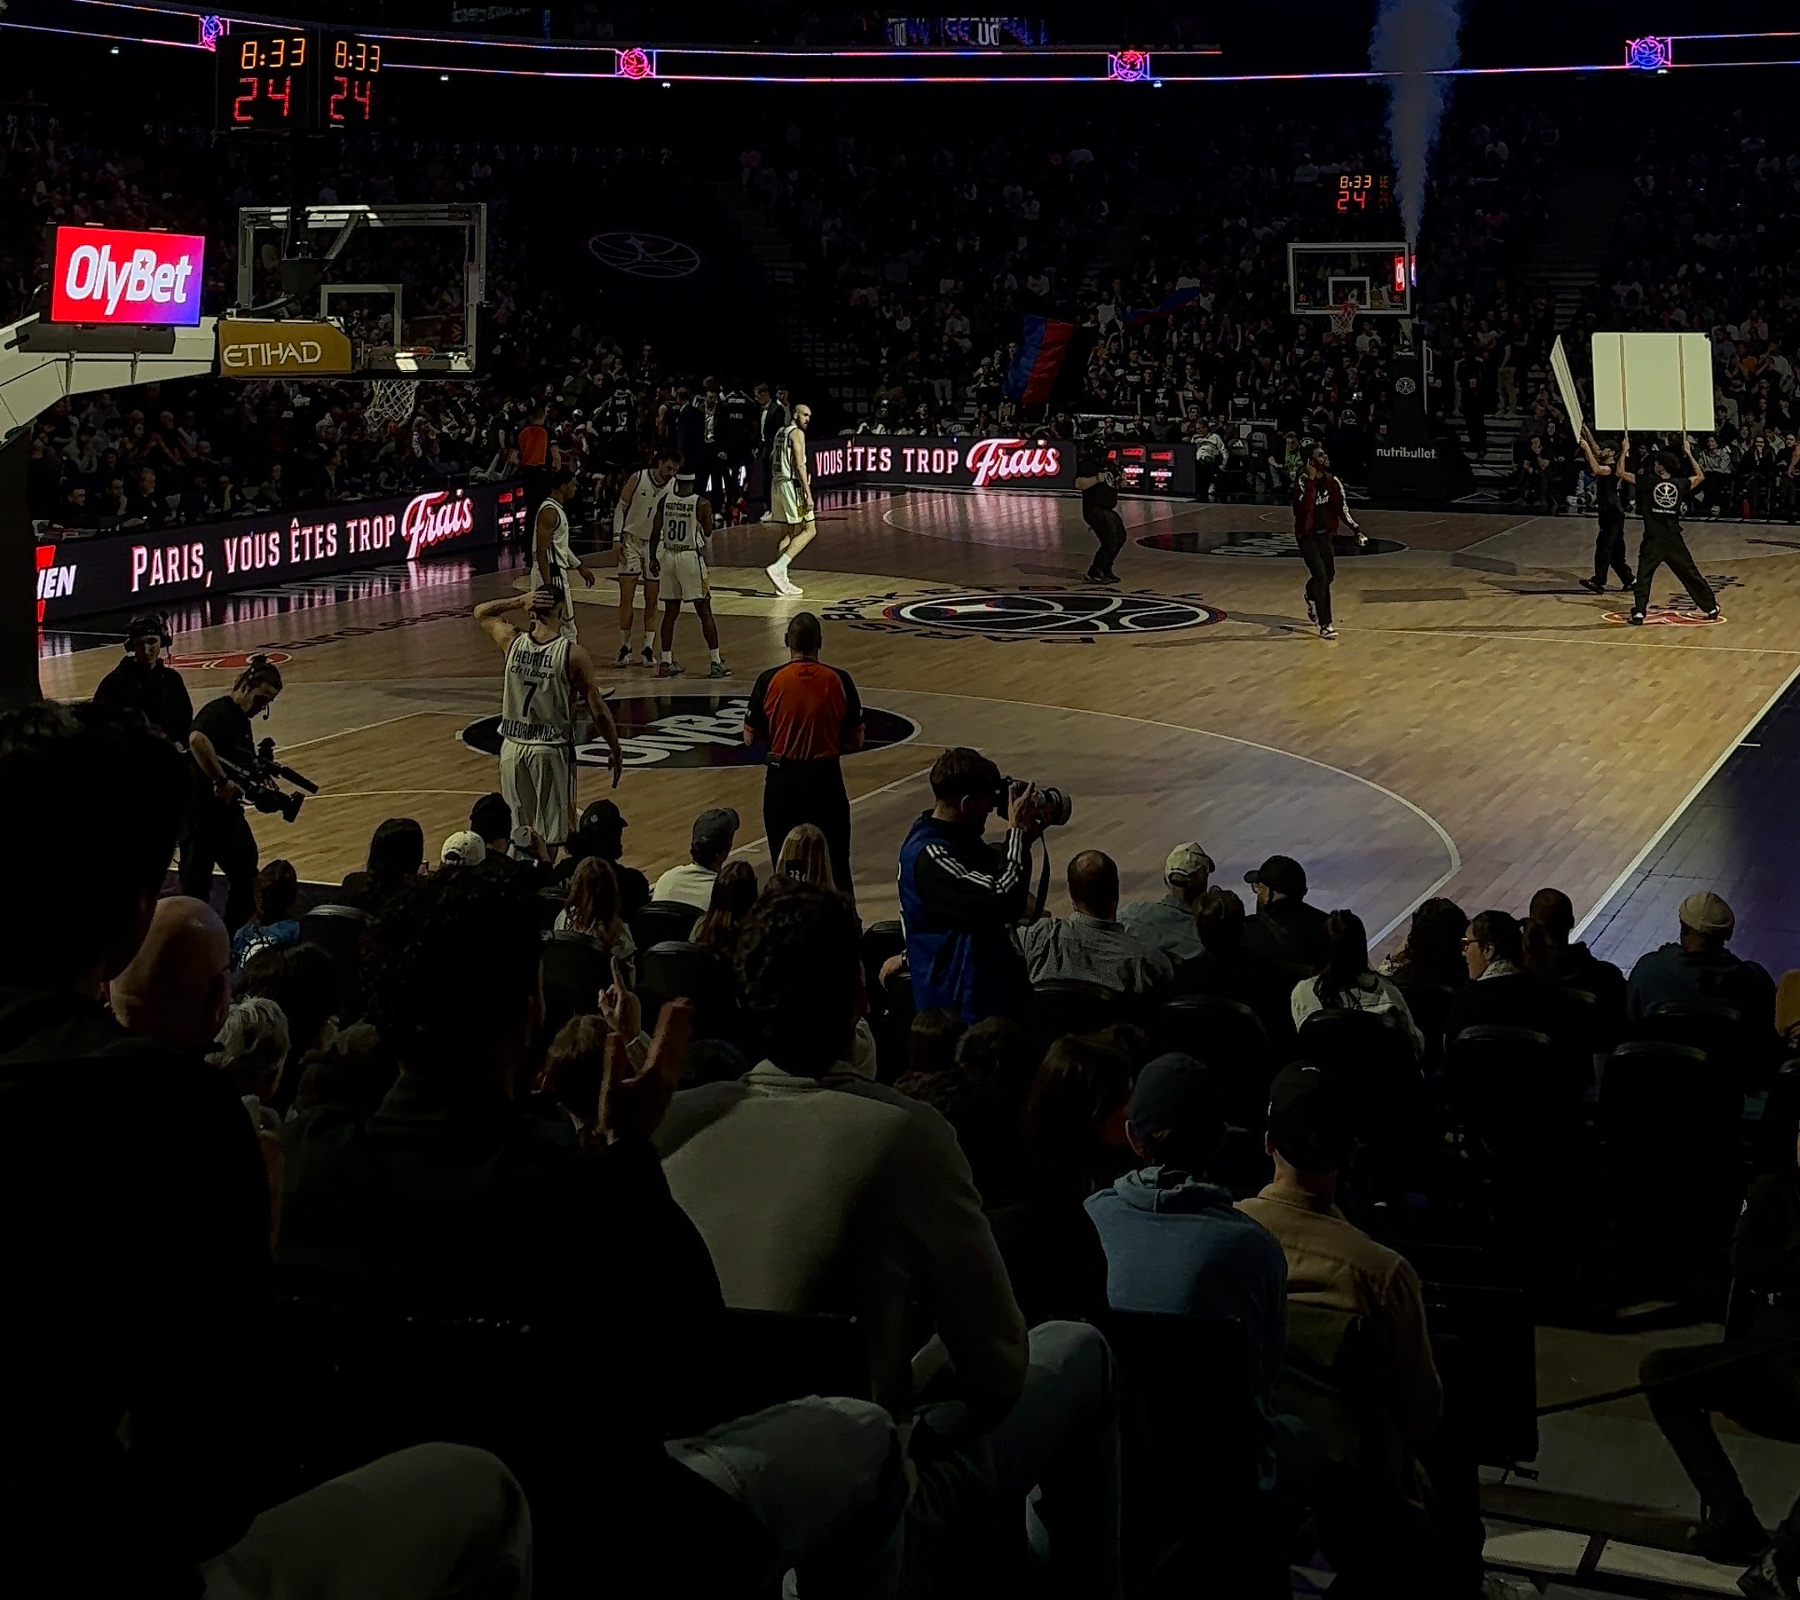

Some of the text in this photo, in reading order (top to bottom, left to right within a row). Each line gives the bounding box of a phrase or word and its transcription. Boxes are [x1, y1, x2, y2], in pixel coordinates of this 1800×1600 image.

[241, 37, 307, 70] 8:33
[334, 39, 381, 73] 8:33
[233, 74, 292, 122] 24
[329, 75, 372, 121] 24
[1339, 174, 1373, 189] 8:33
[1336, 190, 1367, 211] 24
[65, 244, 193, 316] OlyBet
[222, 340, 322, 368] ETIHAD
[814, 447, 844, 478] VOUS
[845, 438, 893, 473] ÊTES
[901, 447, 959, 474] TROP
[964, 437, 1061, 487] Frais
[130, 540, 214, 594] PARIS,
[221, 529, 281, 576] VOUS
[288, 515, 338, 565] ÊTES
[345, 512, 397, 555] TROP
[400, 488, 475, 560] Frais
[666, 519, 688, 542] 30
[522, 680, 538, 718] 7
